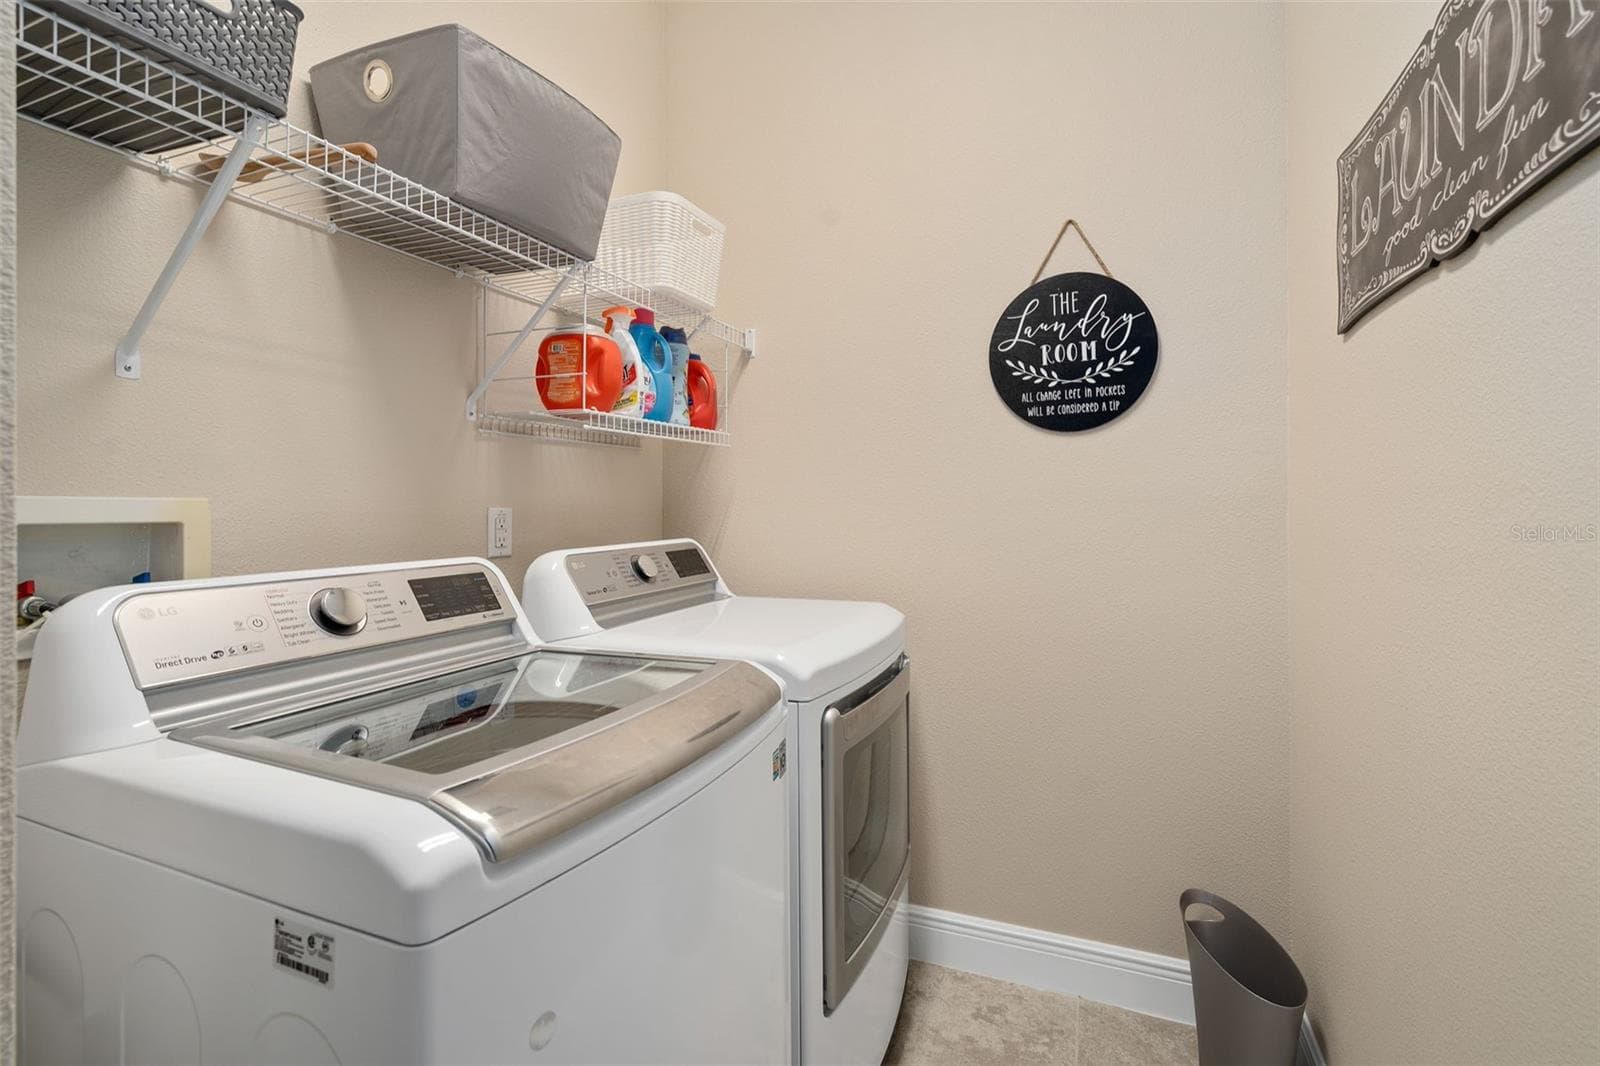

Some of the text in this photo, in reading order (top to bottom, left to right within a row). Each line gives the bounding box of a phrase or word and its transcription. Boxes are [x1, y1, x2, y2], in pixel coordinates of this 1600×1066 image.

[1384, 97, 1550, 267] good clean fun
[1049, 290, 1080, 317] THE
[997, 293, 1147, 352] Laundry
[1040, 340, 1098, 367] ROOM
[158, 606, 178, 616] LG
[154, 658, 184, 670] Direct
[184, 655, 208, 665] Drive
